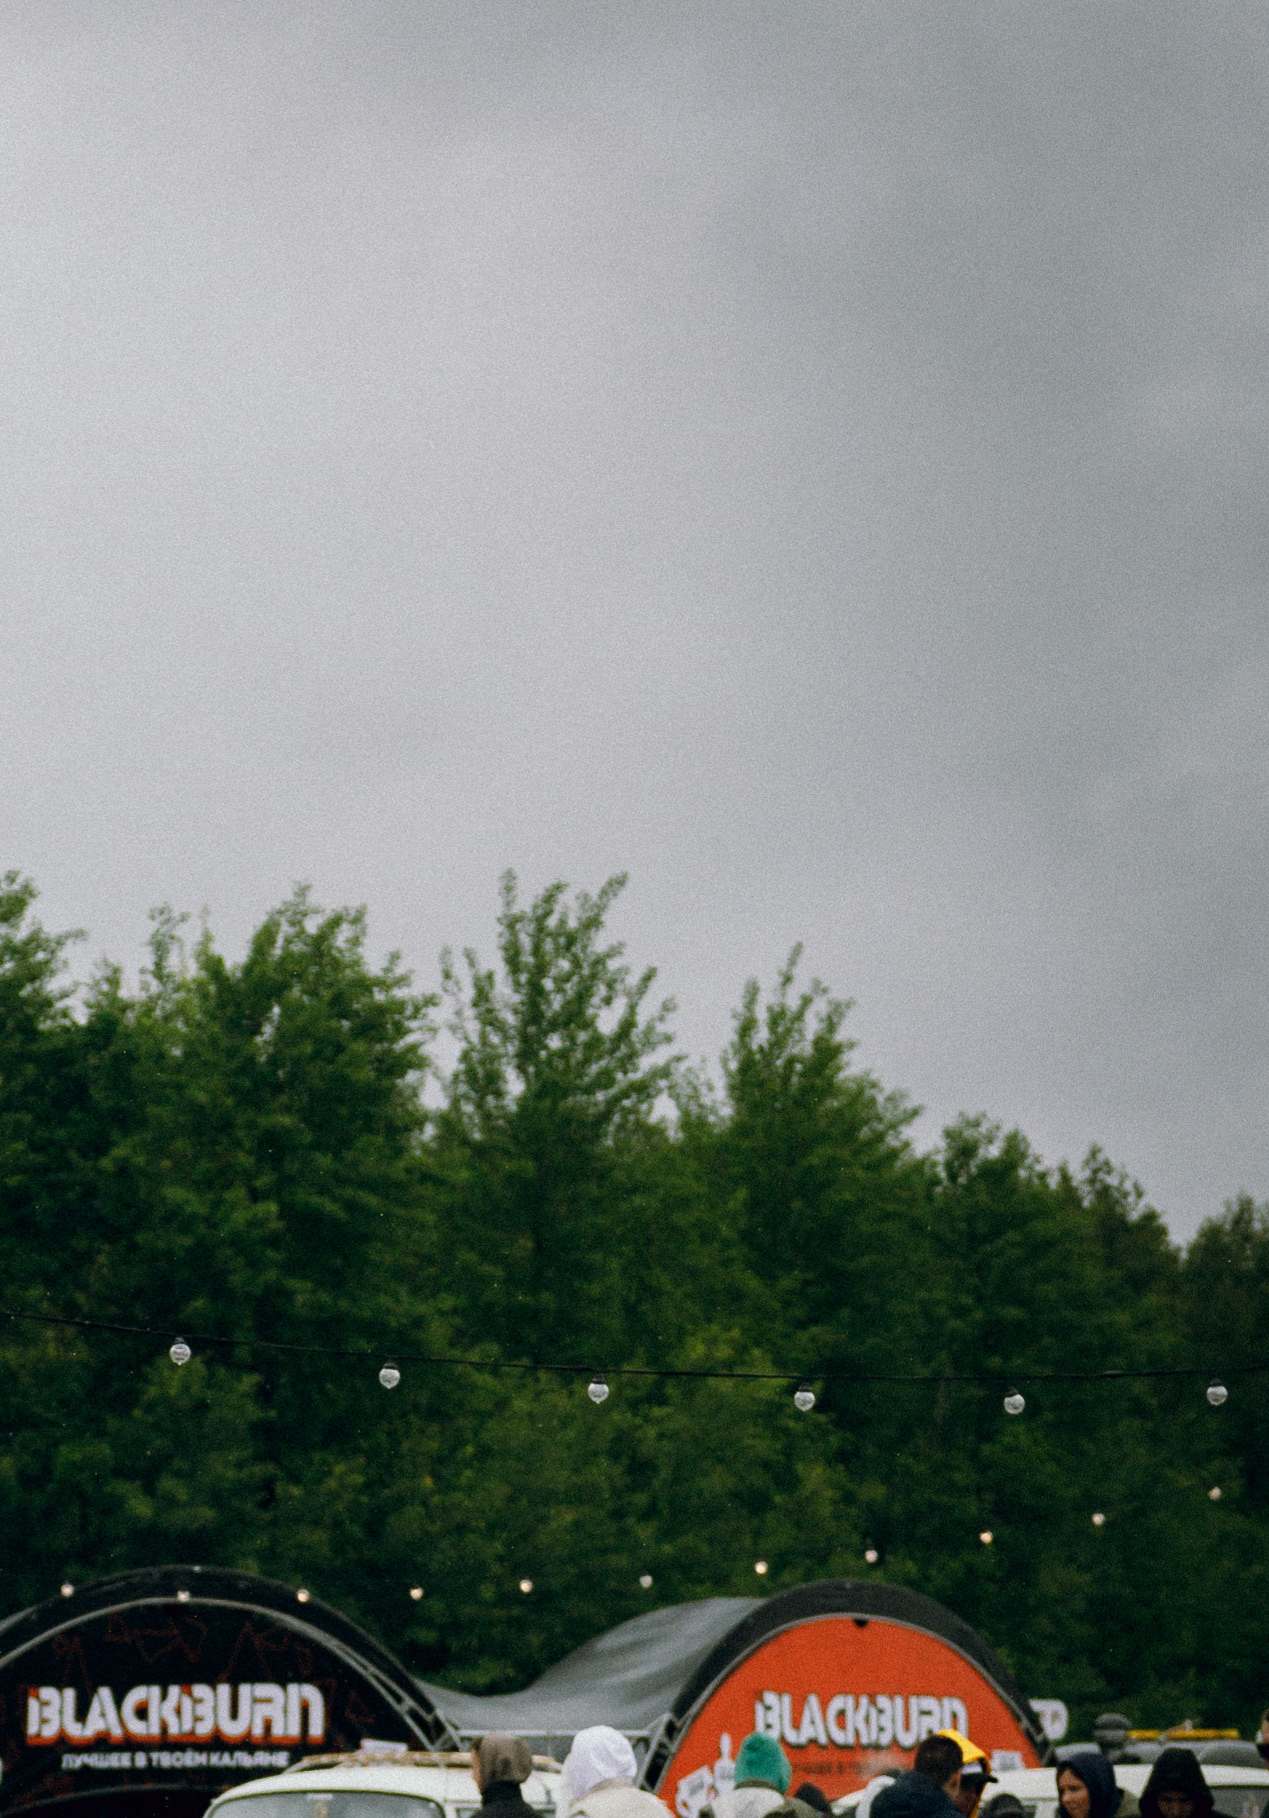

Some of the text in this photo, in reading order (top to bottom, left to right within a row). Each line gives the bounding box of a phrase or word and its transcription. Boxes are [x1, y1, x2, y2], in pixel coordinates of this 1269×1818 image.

[27, 1682, 325, 1743] BLACKBURN
[755, 1691, 969, 1749] BLACKBURN
[134, 1751, 148, 1768] В
